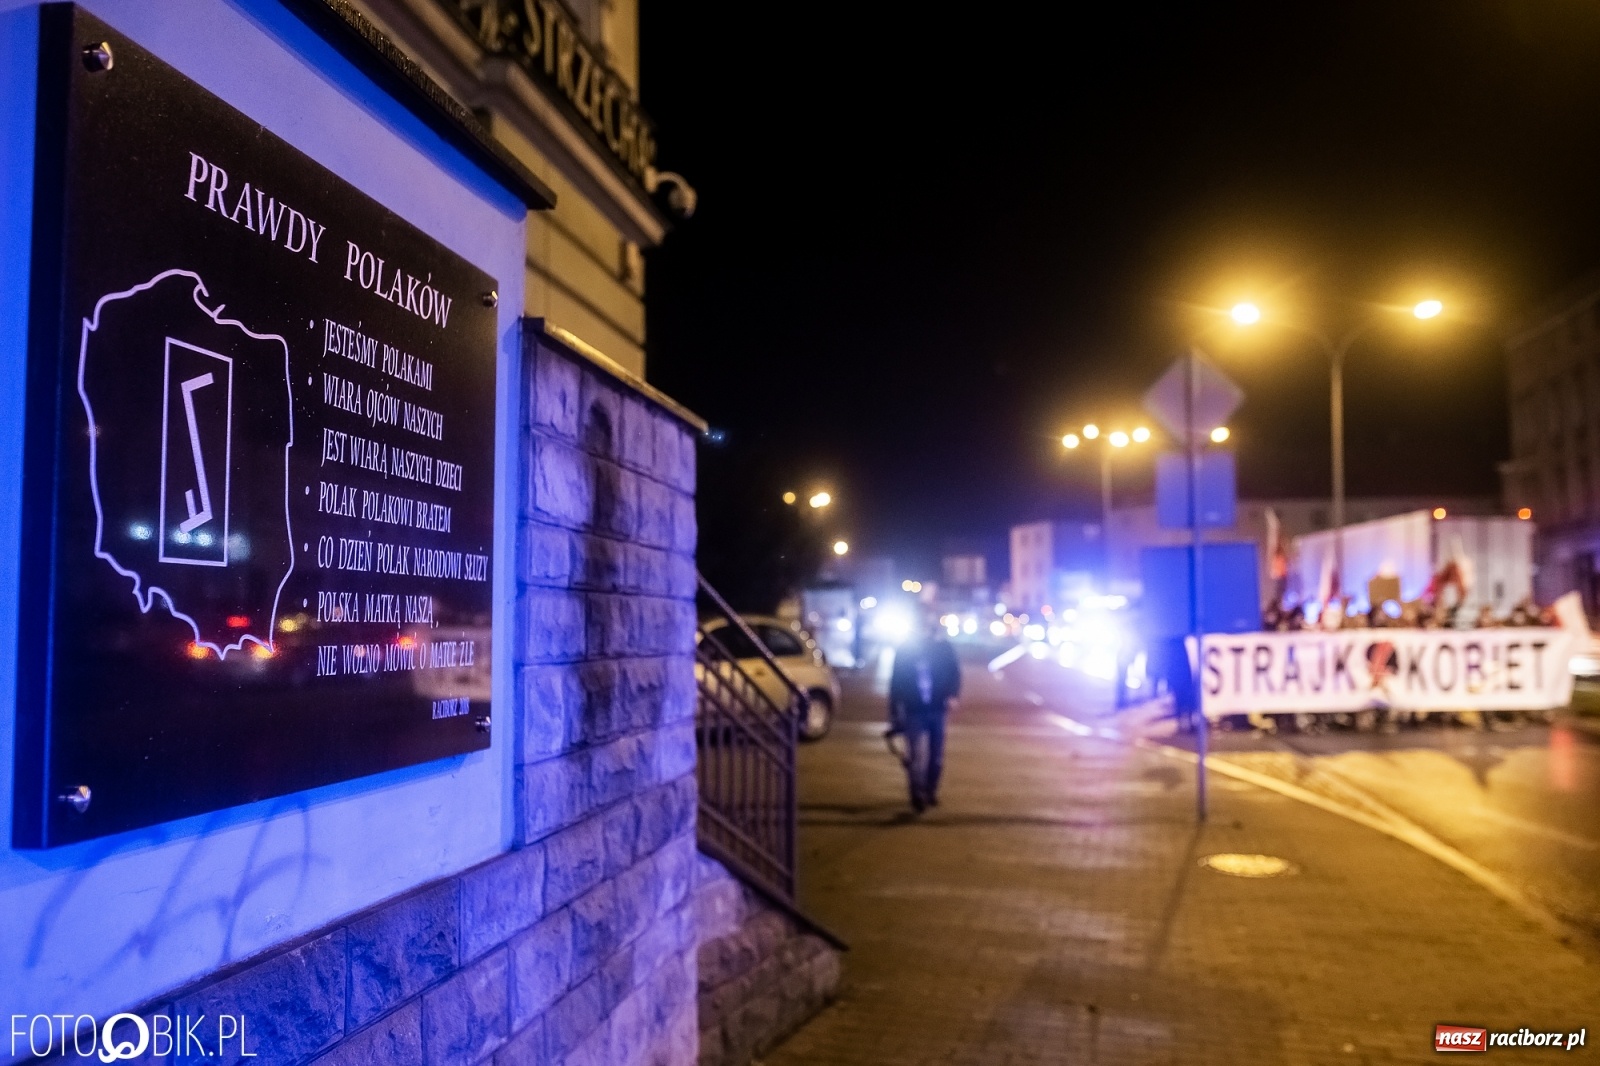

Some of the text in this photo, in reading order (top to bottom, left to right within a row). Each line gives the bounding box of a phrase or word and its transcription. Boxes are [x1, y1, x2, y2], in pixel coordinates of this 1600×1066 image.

[184, 151, 452, 329] PRAWDY POLAKÓW
[322, 318, 433, 391] JESTEŚMY POLAKAMI
[323, 372, 443, 441] WIARA OJCÓW NASZYCH
[321, 427, 463, 491] JEST WIARĄ NASZYCH DZIECI
[318, 481, 451, 533] POLAK POLAKOWI BRATEM
[317, 530, 489, 582] CO DZIEŃ POLAK NARODOWI SŁUŻY
[316, 591, 360, 623] POLSKA
[363, 593, 401, 629] MATKĄ
[316, 645, 338, 676] NIE
[342, 643, 380, 675] WOLNO
[383, 631, 418, 672] MÓWIĆ
[419, 643, 427, 670] O
[429, 641, 457, 669] MATCE
[1204, 642, 1549, 695] STRAJK KOBIET
